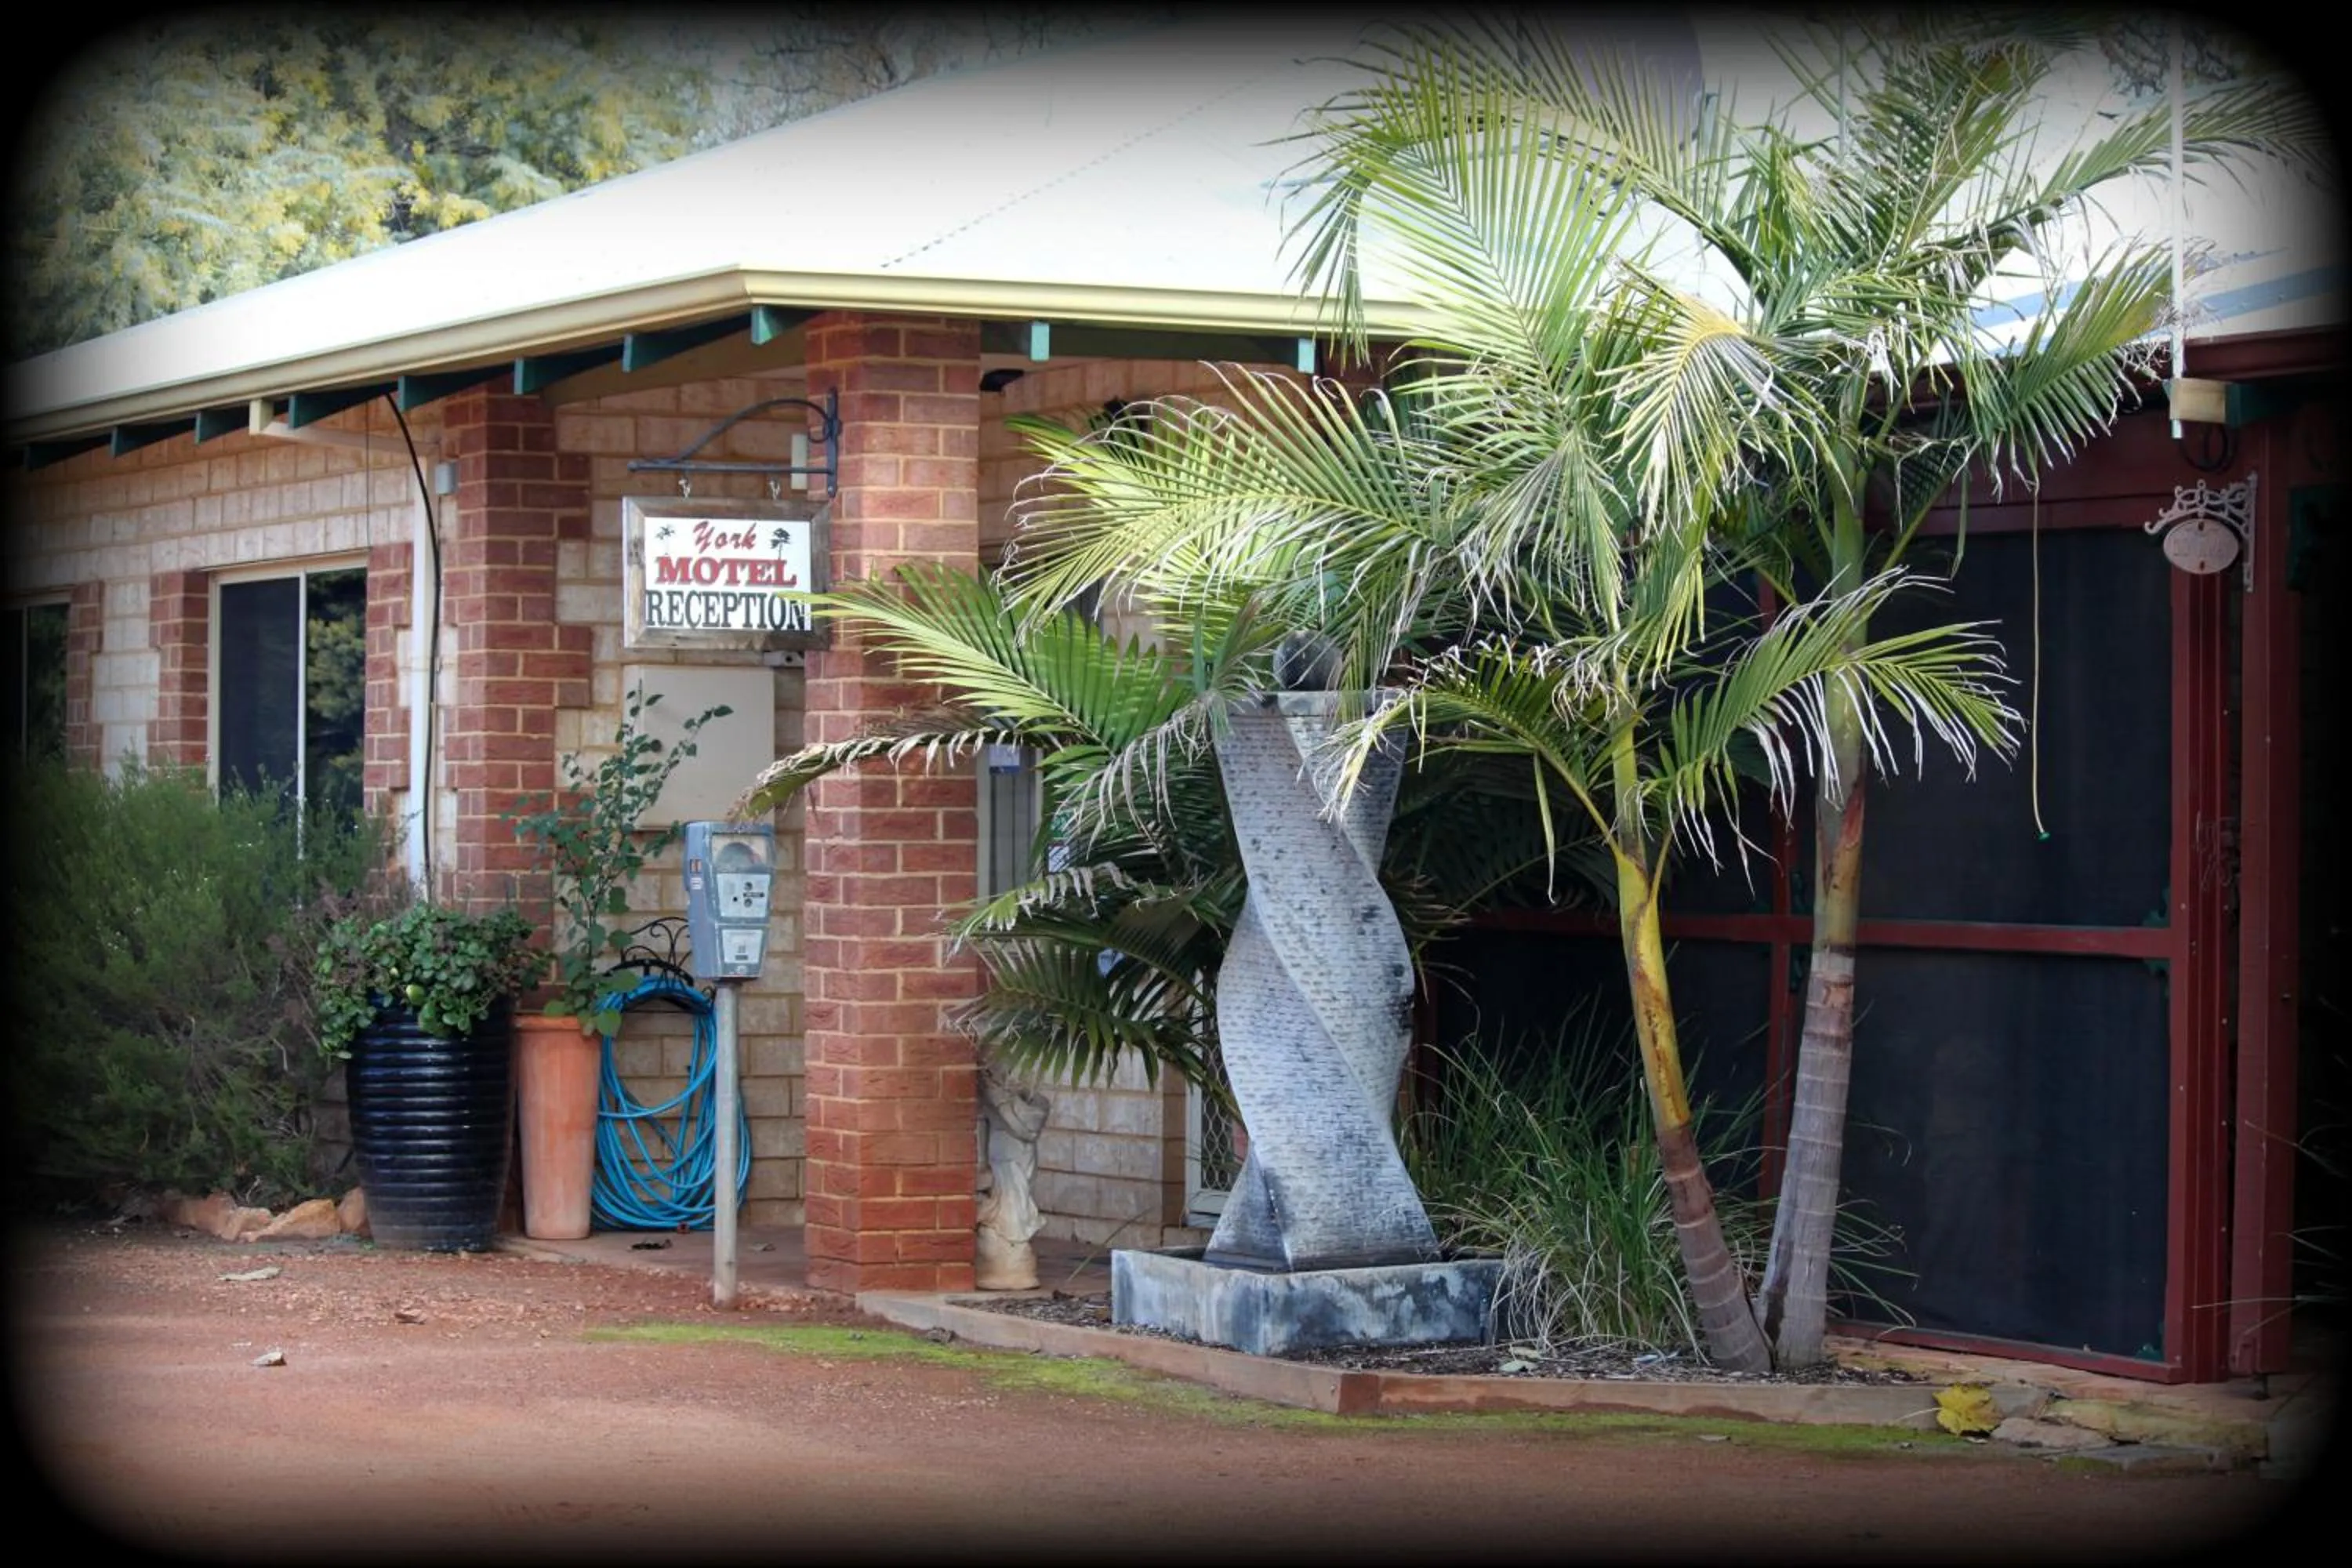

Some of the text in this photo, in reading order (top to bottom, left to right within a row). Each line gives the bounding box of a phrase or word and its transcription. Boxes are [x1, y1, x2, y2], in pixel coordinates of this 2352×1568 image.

[693, 521, 757, 554] York
[655, 556, 797, 586] MOTEL
[646, 590, 806, 630] RECEPTION
